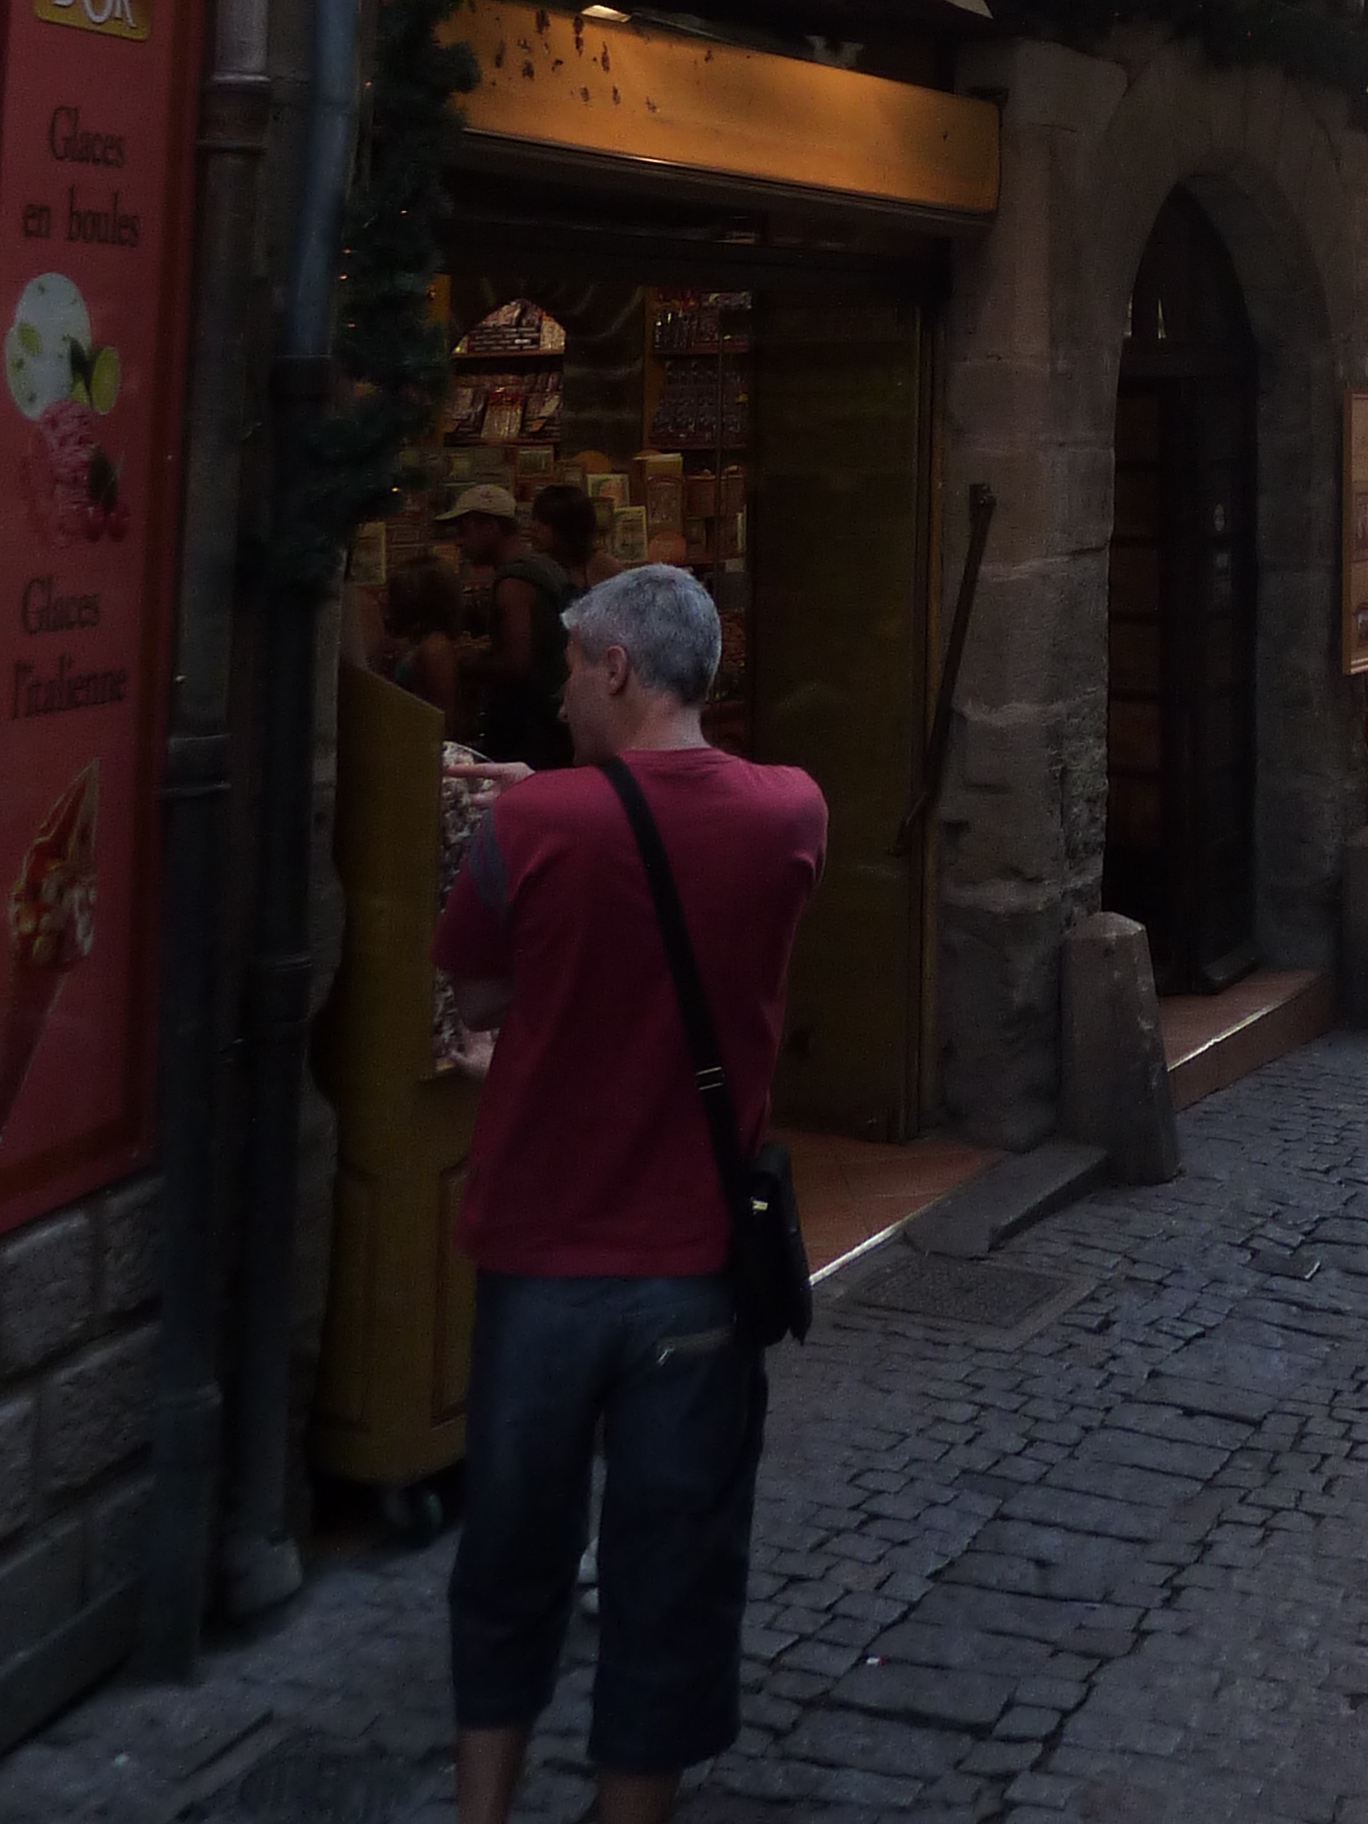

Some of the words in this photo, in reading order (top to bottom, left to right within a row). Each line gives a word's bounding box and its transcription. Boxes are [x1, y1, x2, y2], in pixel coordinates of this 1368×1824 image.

[49, 105, 126, 168] Glaces
[22, 203, 51, 239] en
[65, 183, 141, 247] boules
[20, 575, 101, 635] Glaces
